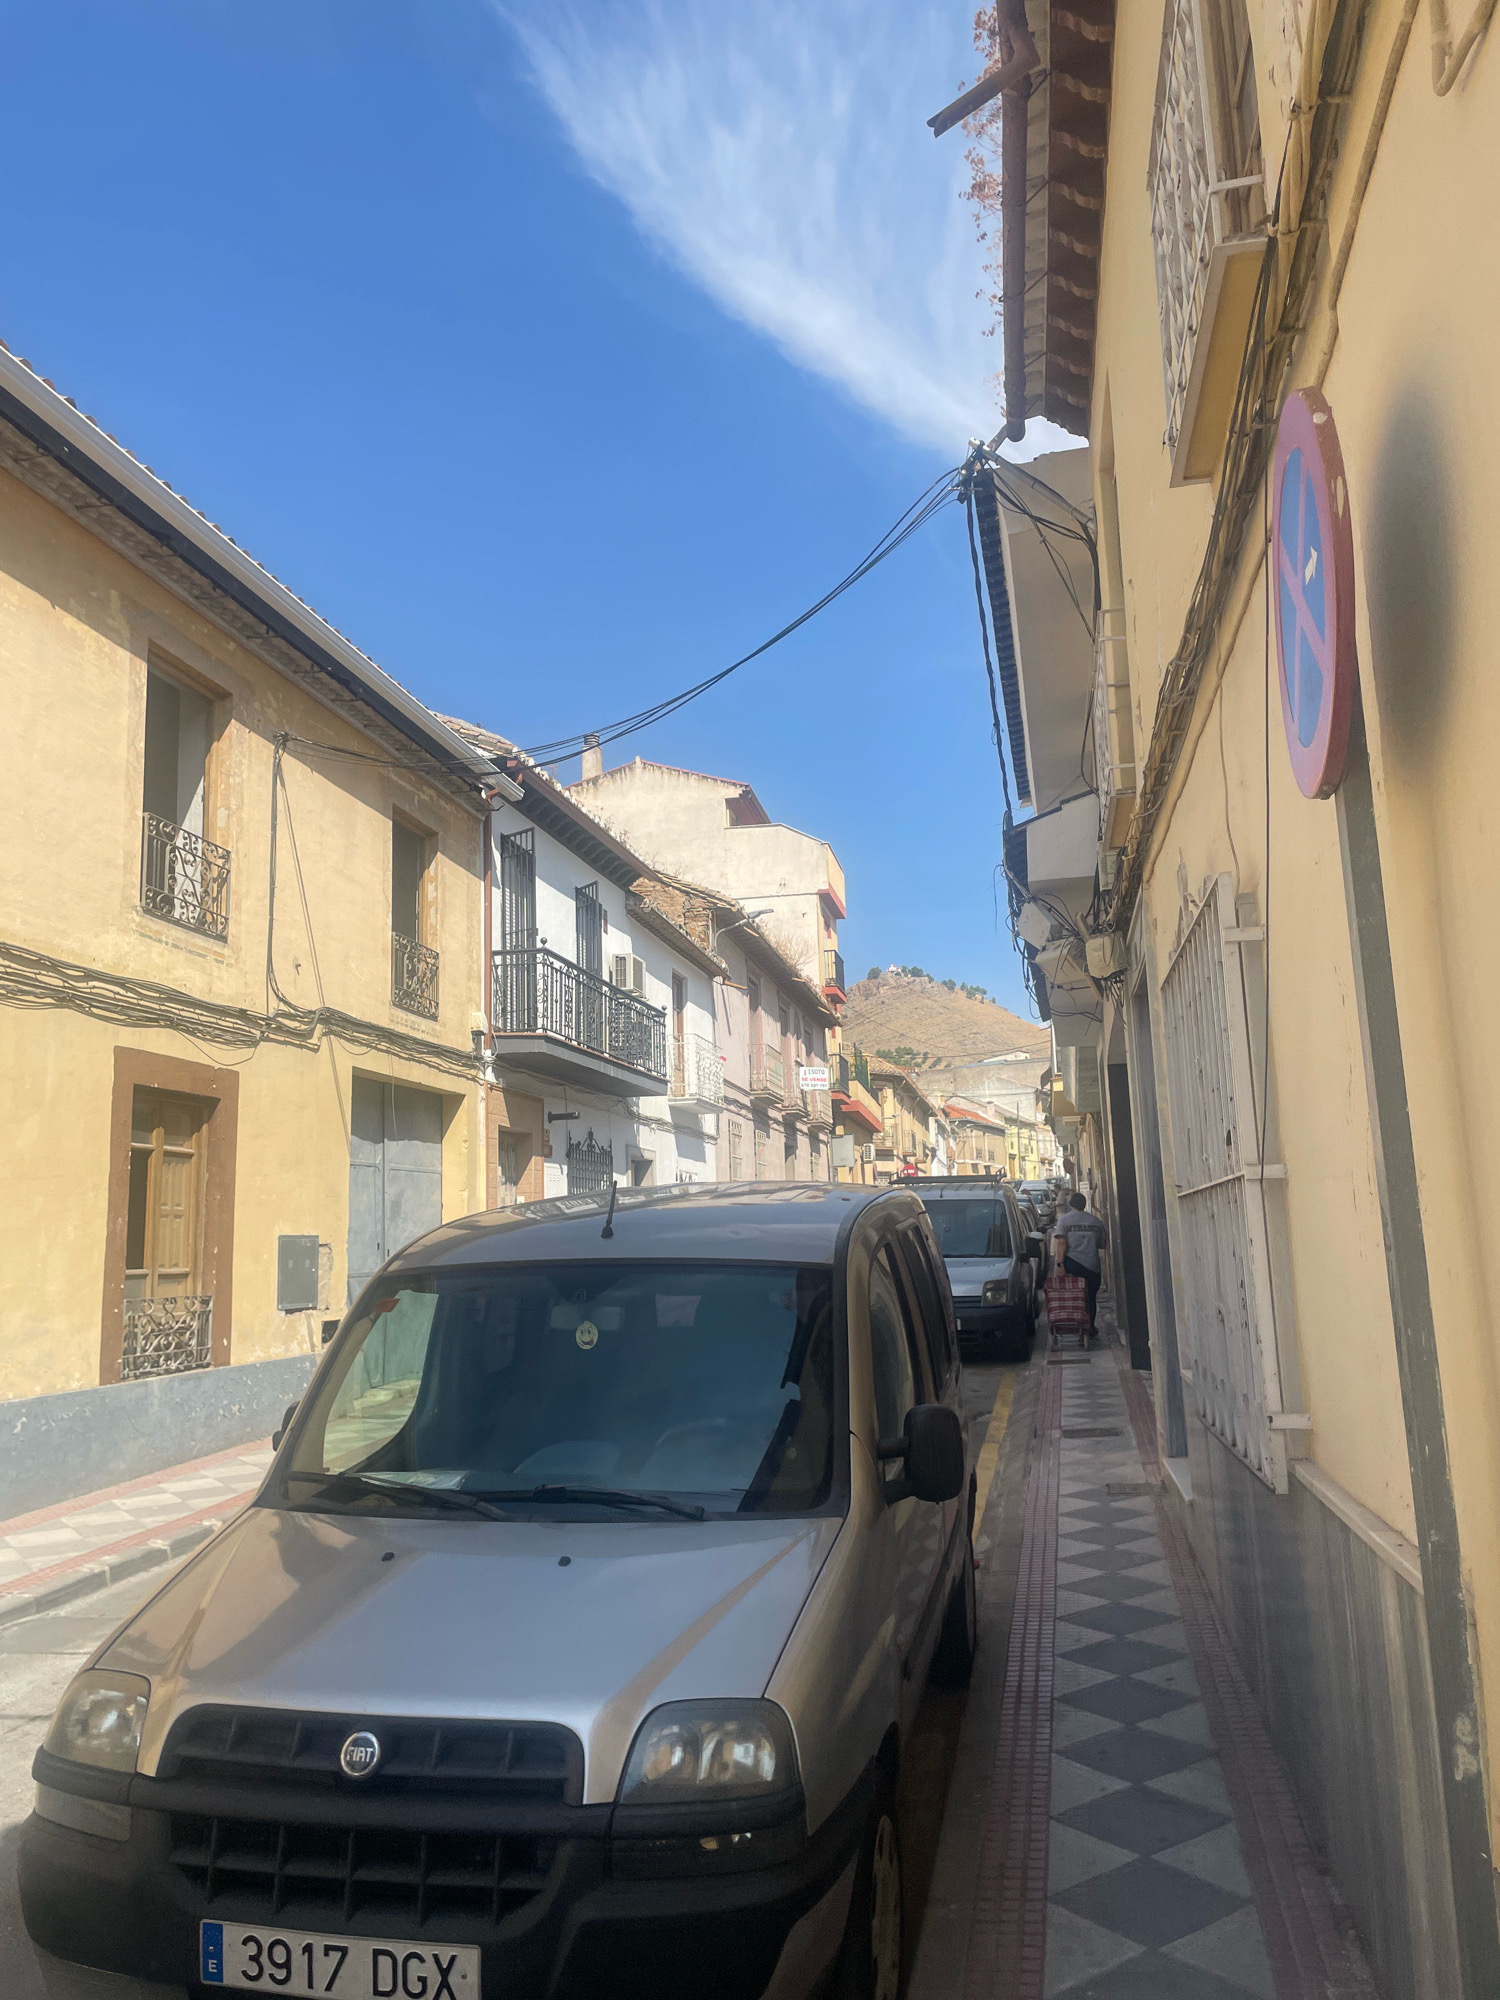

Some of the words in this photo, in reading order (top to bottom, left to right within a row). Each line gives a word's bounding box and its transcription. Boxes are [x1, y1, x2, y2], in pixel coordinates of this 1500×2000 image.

[346, 1746, 374, 1762] FIAT
[208, 1959, 218, 1973] E
[241, 1935, 348, 1992] 3917
[372, 1948, 458, 2000] DGX
